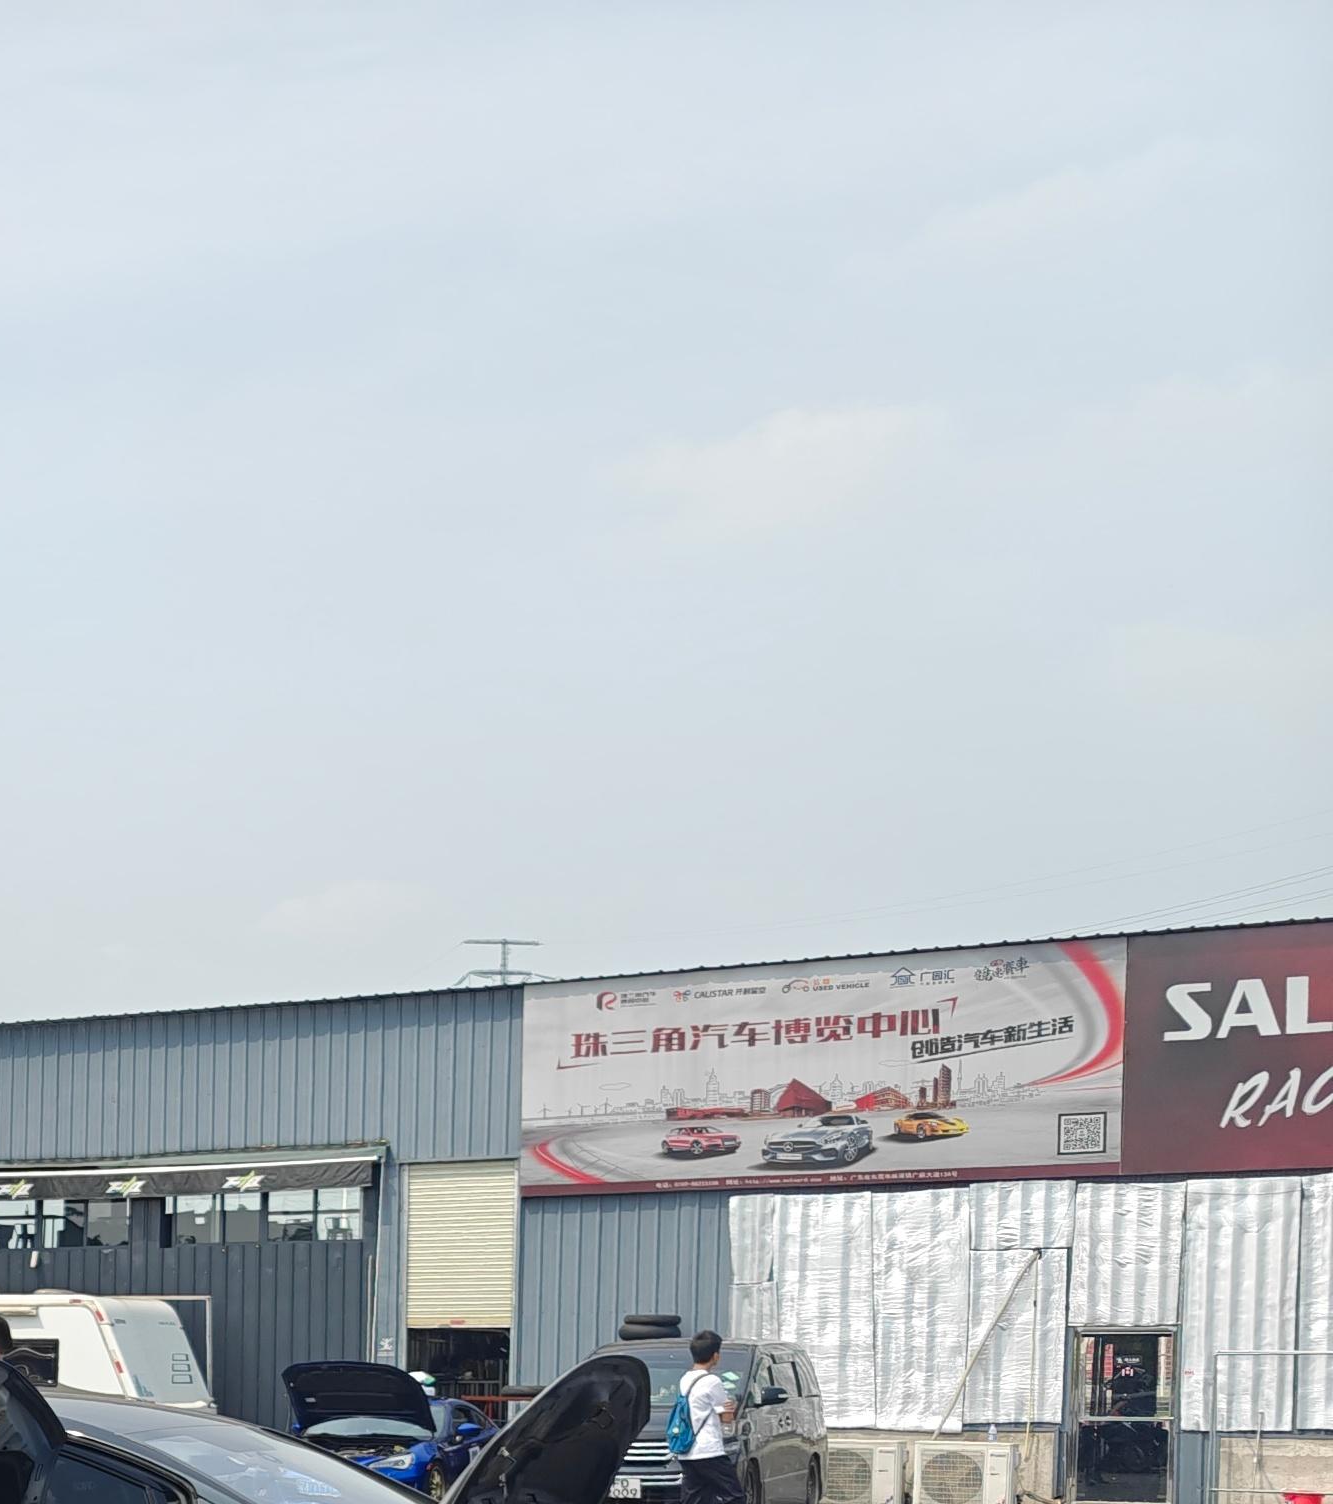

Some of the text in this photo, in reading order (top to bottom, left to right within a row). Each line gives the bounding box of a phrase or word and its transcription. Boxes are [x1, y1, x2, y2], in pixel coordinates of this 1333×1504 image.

[836, 981, 870, 990] VEHICLE
[569, 1008, 940, 1058] 珠三角汽车博览中心
[910, 1015, 1075, 1059] 创造汽车新生活
